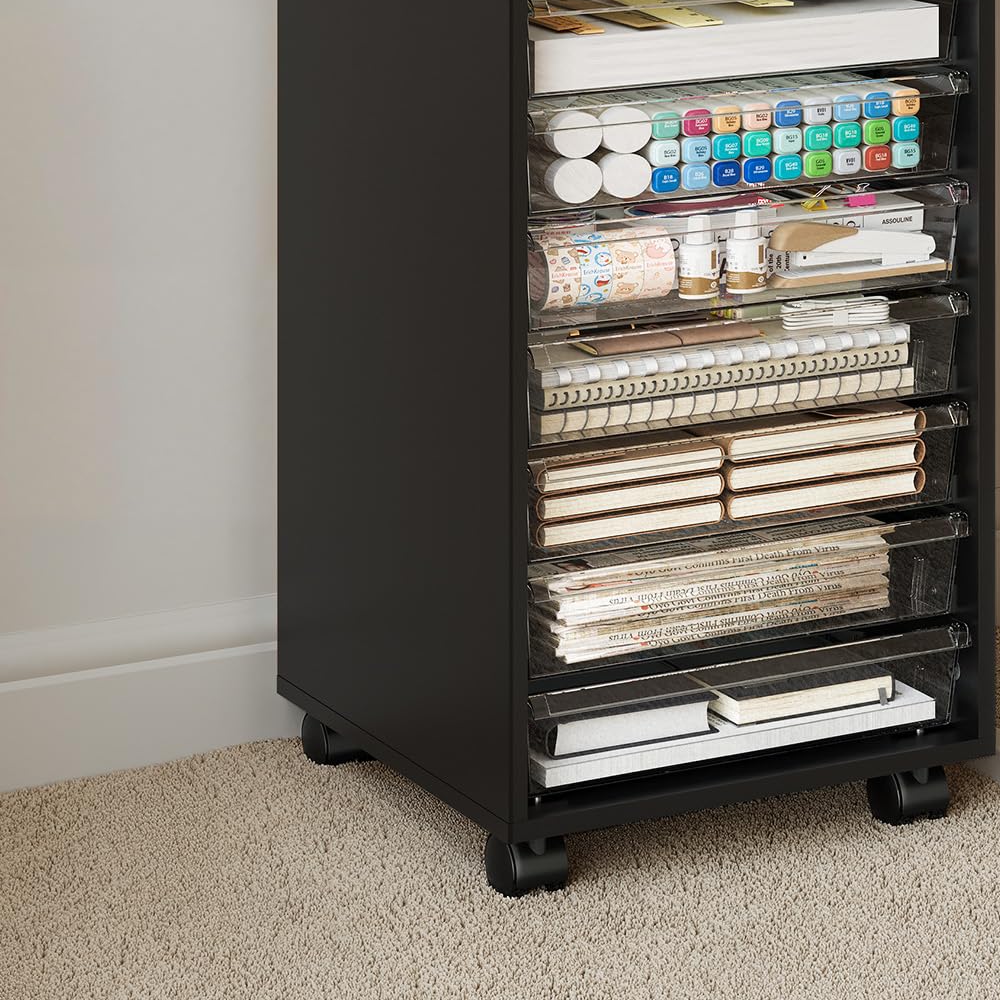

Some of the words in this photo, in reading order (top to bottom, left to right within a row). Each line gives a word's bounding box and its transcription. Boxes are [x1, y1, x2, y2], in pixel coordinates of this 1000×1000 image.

[882, 216, 913, 225] ASSOULINE
[756, 550, 784, 561] Death
[786, 547, 813, 557] From
[814, 545, 841, 553] Virus
[758, 589, 786, 600] Death
[788, 586, 814, 596] From
[816, 582, 842, 591] Virus
